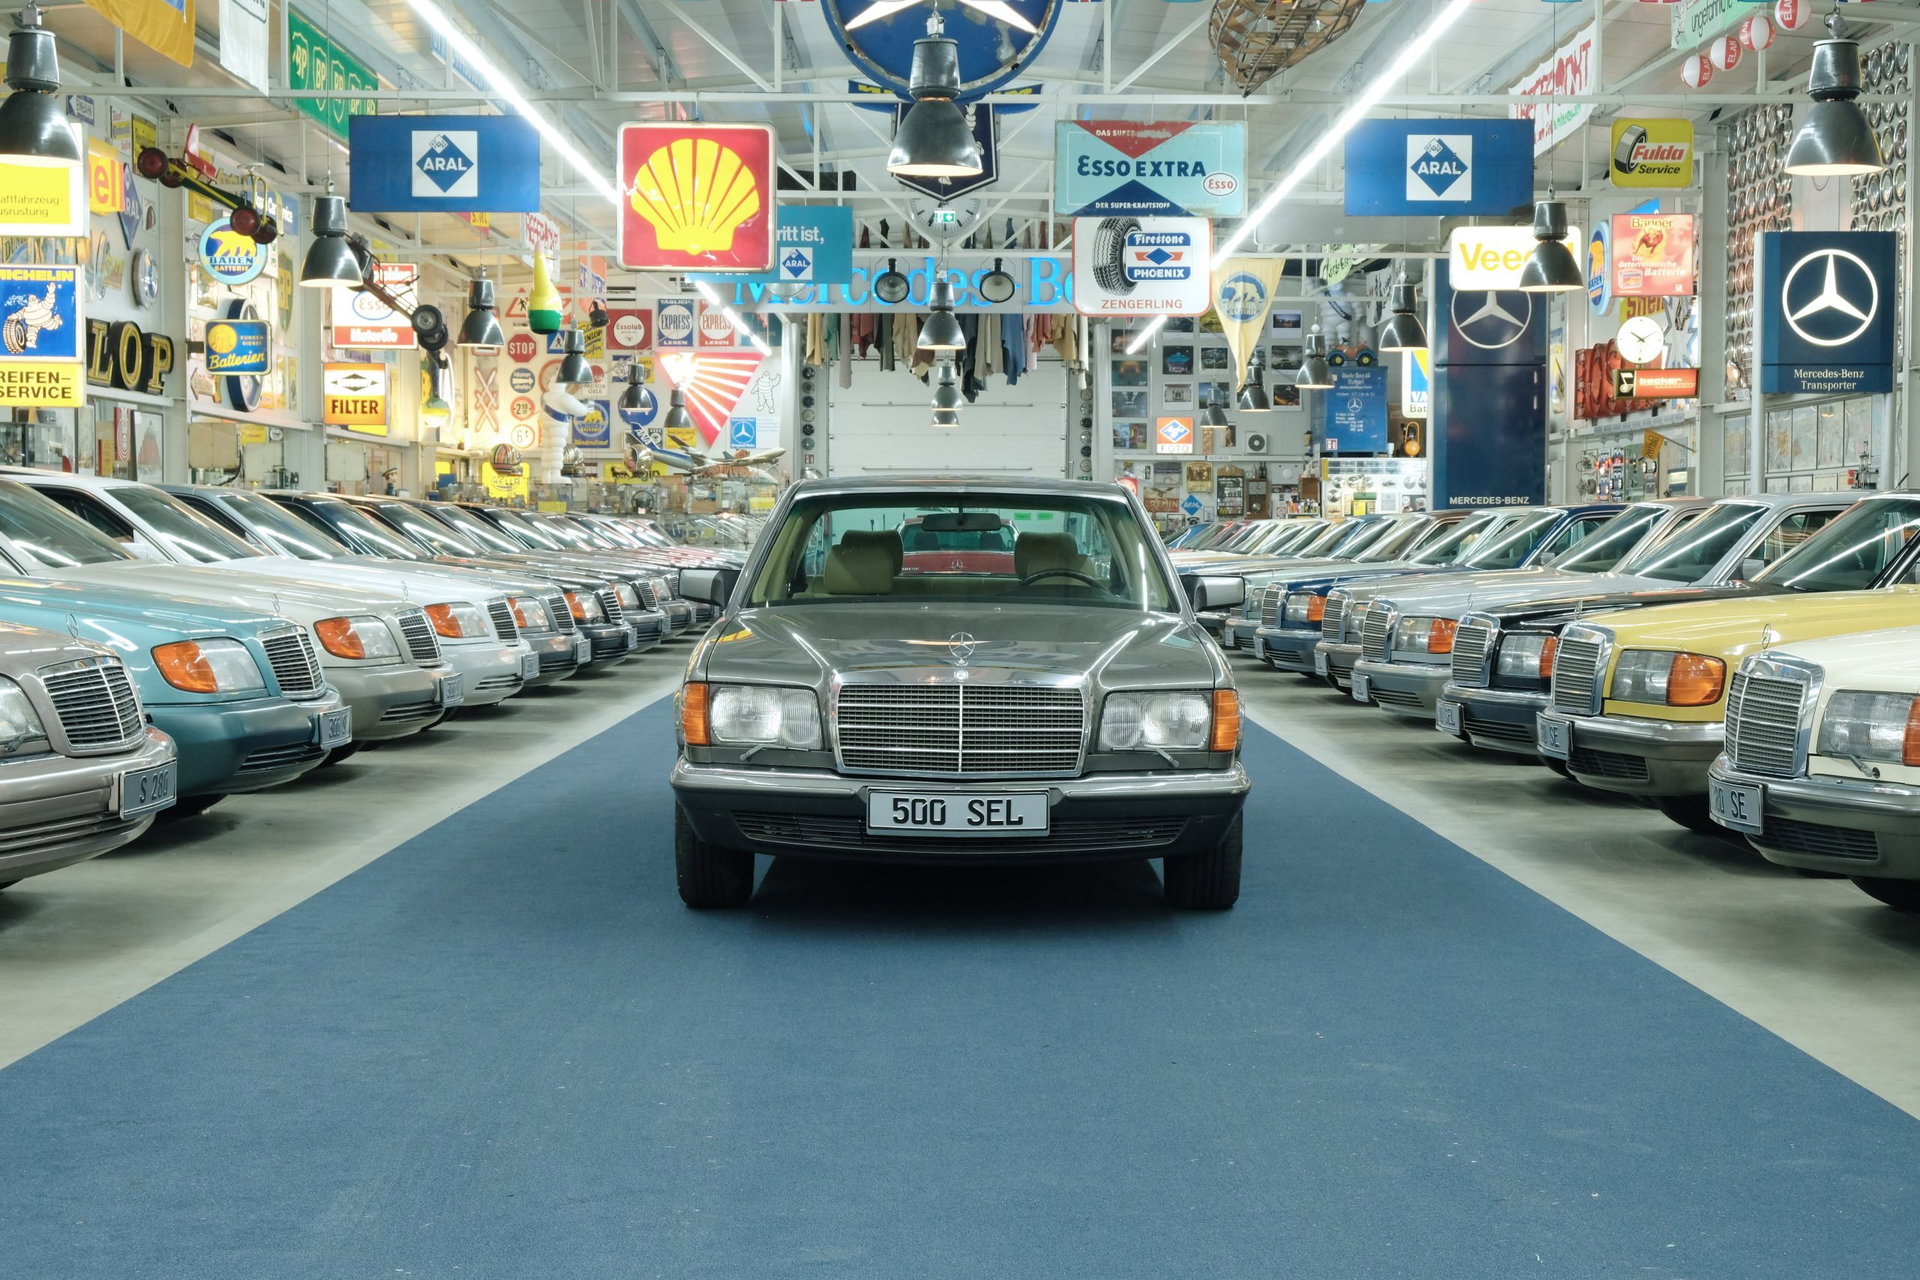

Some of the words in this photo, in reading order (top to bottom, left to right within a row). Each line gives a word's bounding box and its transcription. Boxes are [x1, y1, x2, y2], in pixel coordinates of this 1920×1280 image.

[1727, 39, 1737, 63] ELAN
[1702, 57, 1712, 81] ELAN
[1095, 129, 1111, 137] DAS
[1632, 145, 1685, 161] Fulda
[423, 157, 468, 171] ARAL
[1135, 160, 1207, 177] EXTRA
[1417, 161, 1462, 175] ARAL
[1638, 164, 1681, 174] Service
[1095, 201, 1109, 209] DER
[1631, 217, 1672, 228] Banner
[801, 226, 825, 244] ist,
[1133, 232, 1185, 245] Firestone
[784, 259, 808, 268] ARAL
[1133, 269, 1186, 279] PHOENIX
[1644, 268, 1686, 277] Batterie
[1101, 299, 1184, 309] ZENGERLING
[661, 314, 691, 330] EXPRESS
[508, 342, 536, 355] STOP
[207, 349, 265, 370] Batterien
[1793, 368, 1865, 379] Mercedes-Benz
[1801, 380, 1857, 392] Transporter
[331, 399, 379, 415] FILTER
[1160, 445, 1189, 453] FOTO
[1449, 496, 1530, 505] MERCEDES-BENZ
[1549, 725, 1559, 748] SE
[139, 775, 148, 801] S
[1730, 789, 1748, 820] SE
[892, 798, 946, 825] 500
[967, 798, 1023, 826] SEL
